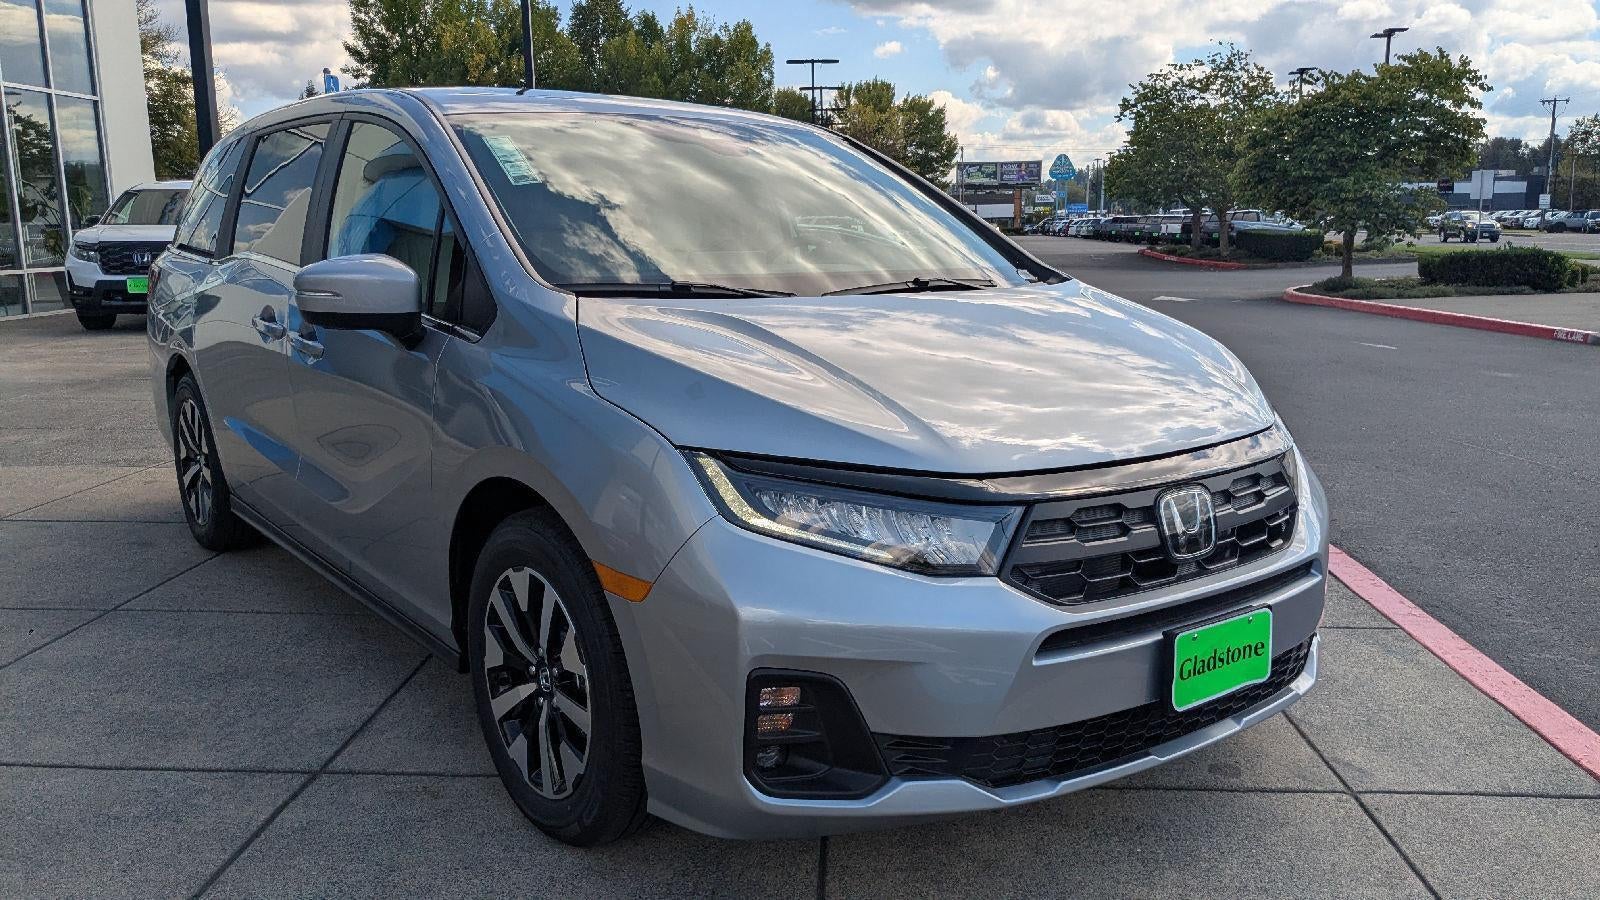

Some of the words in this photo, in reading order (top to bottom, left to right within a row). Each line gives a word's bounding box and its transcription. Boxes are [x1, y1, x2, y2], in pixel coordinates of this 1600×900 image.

[1553, 330, 1567, 340] FIRE
[1567, 331, 1584, 342] LANE
[1179, 641, 1265, 681] Gladstone
